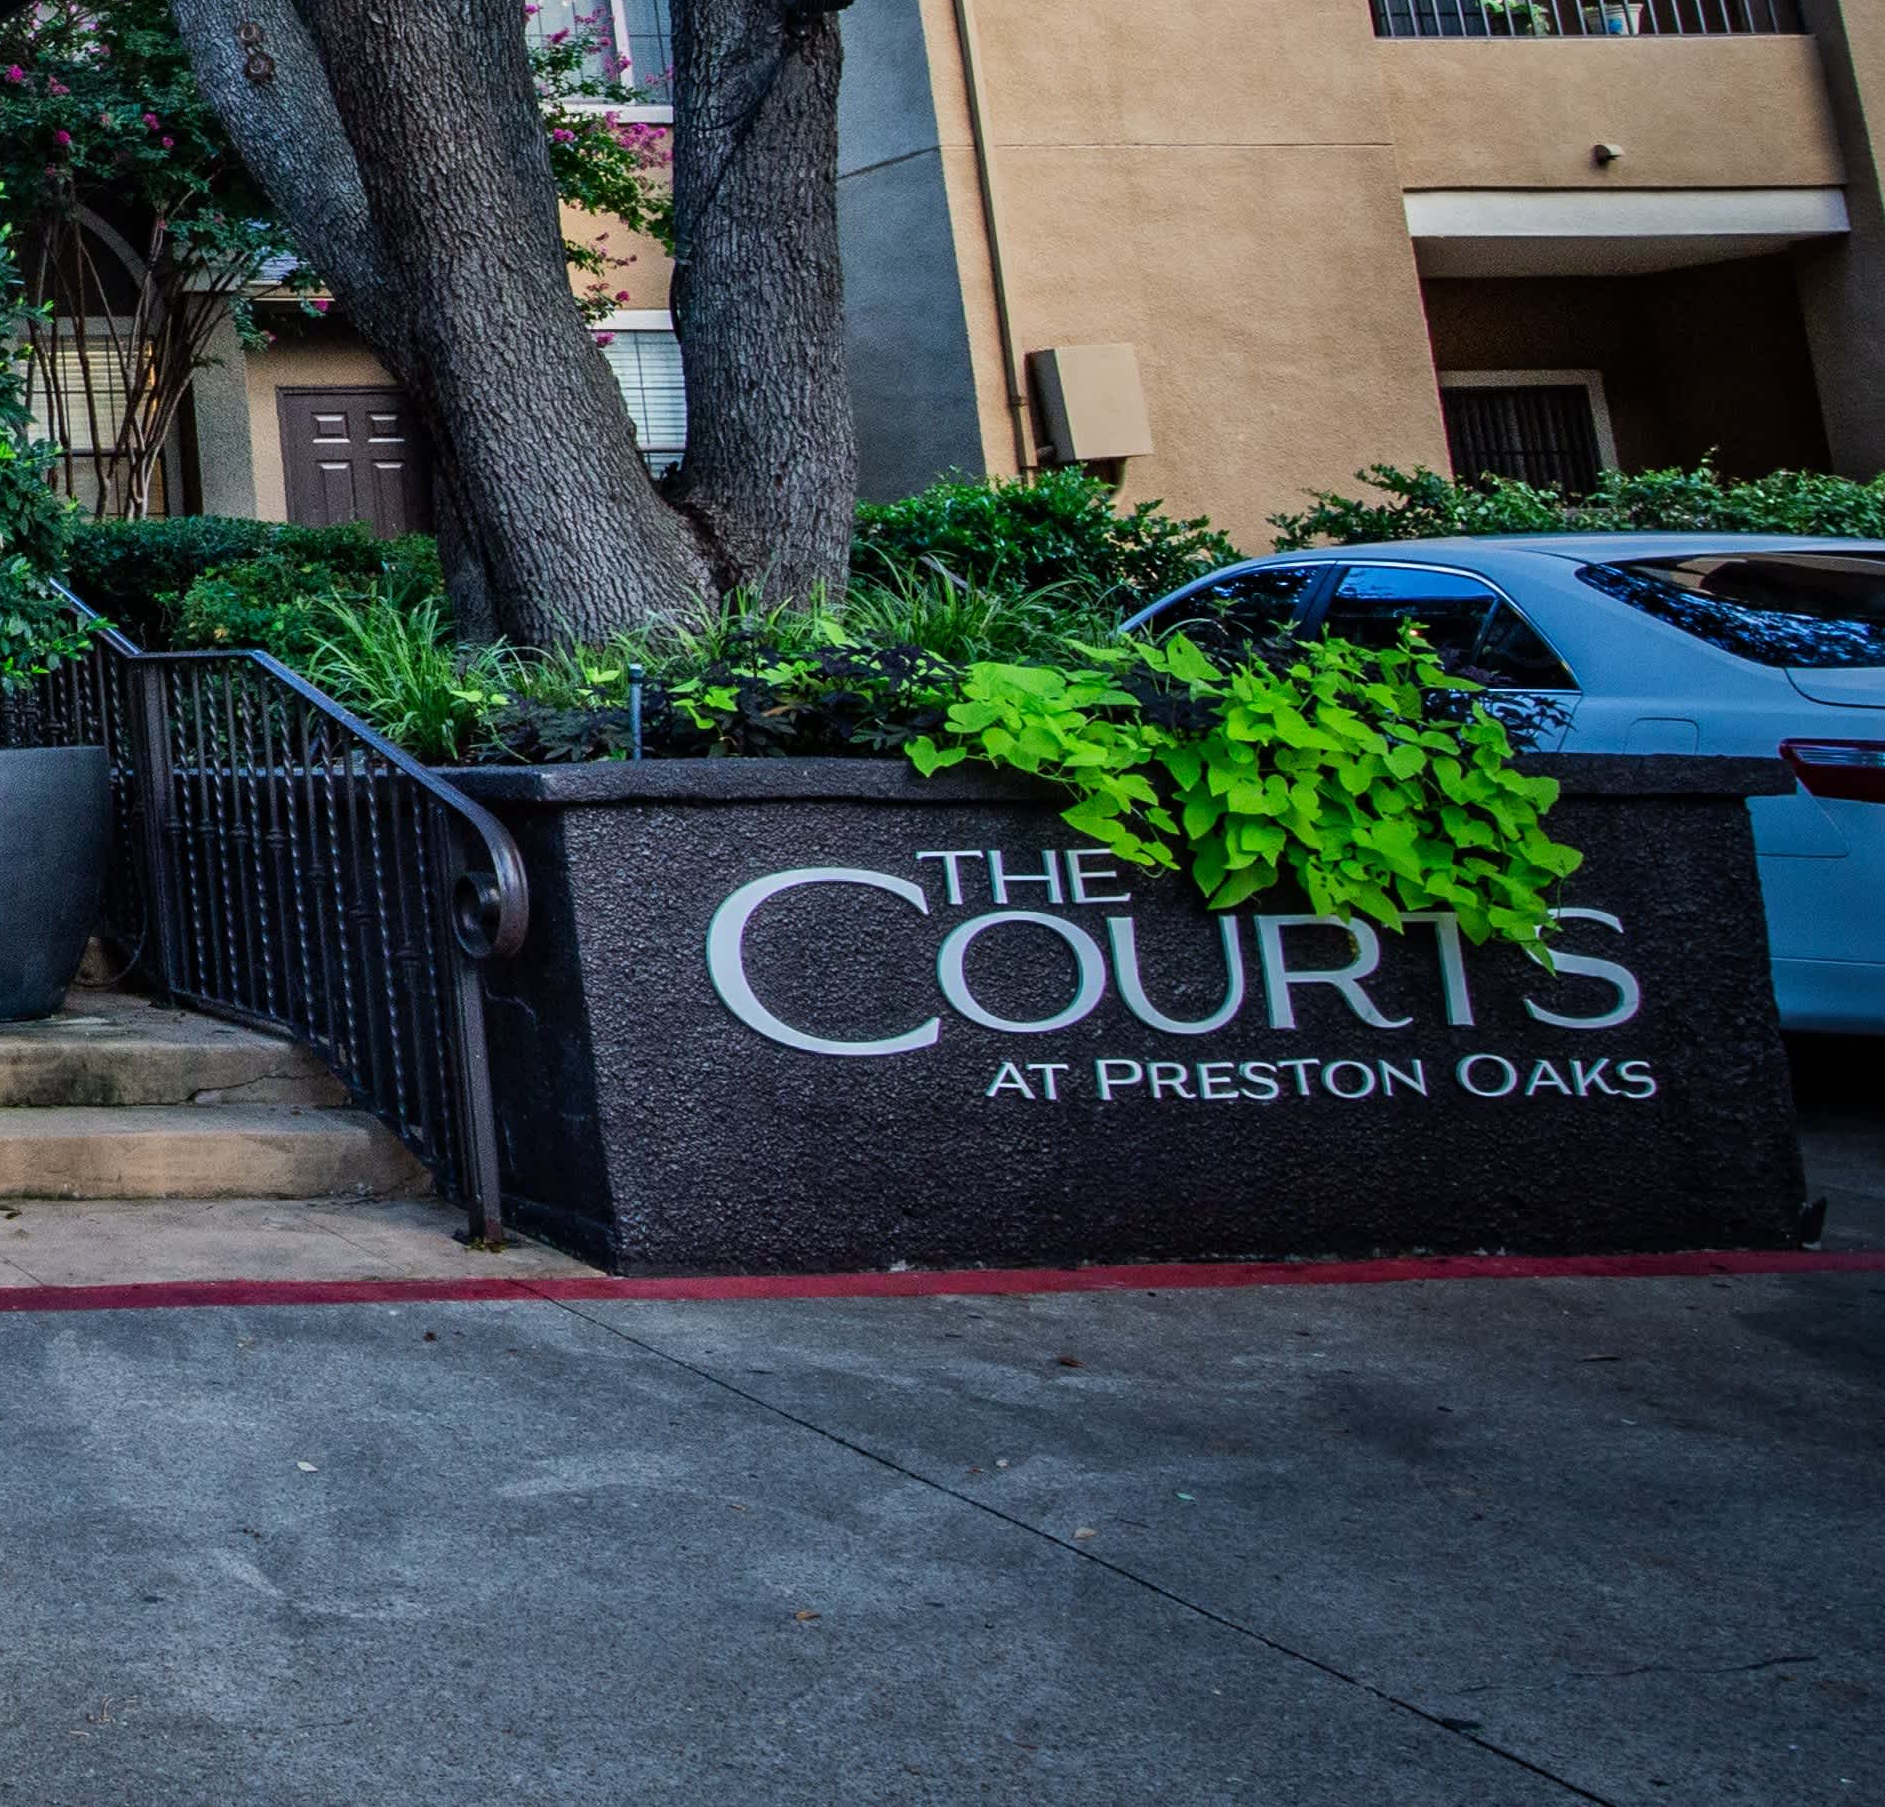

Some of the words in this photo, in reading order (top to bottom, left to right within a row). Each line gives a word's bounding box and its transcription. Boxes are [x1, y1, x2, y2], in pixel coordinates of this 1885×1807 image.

[916, 848, 1131, 906] THE
[706, 866, 1641, 1057] COURTS
[985, 1060, 1070, 1100] AT
[1095, 1058, 1428, 1101] PRESTON
[1460, 1053, 1657, 1100] OAKS
